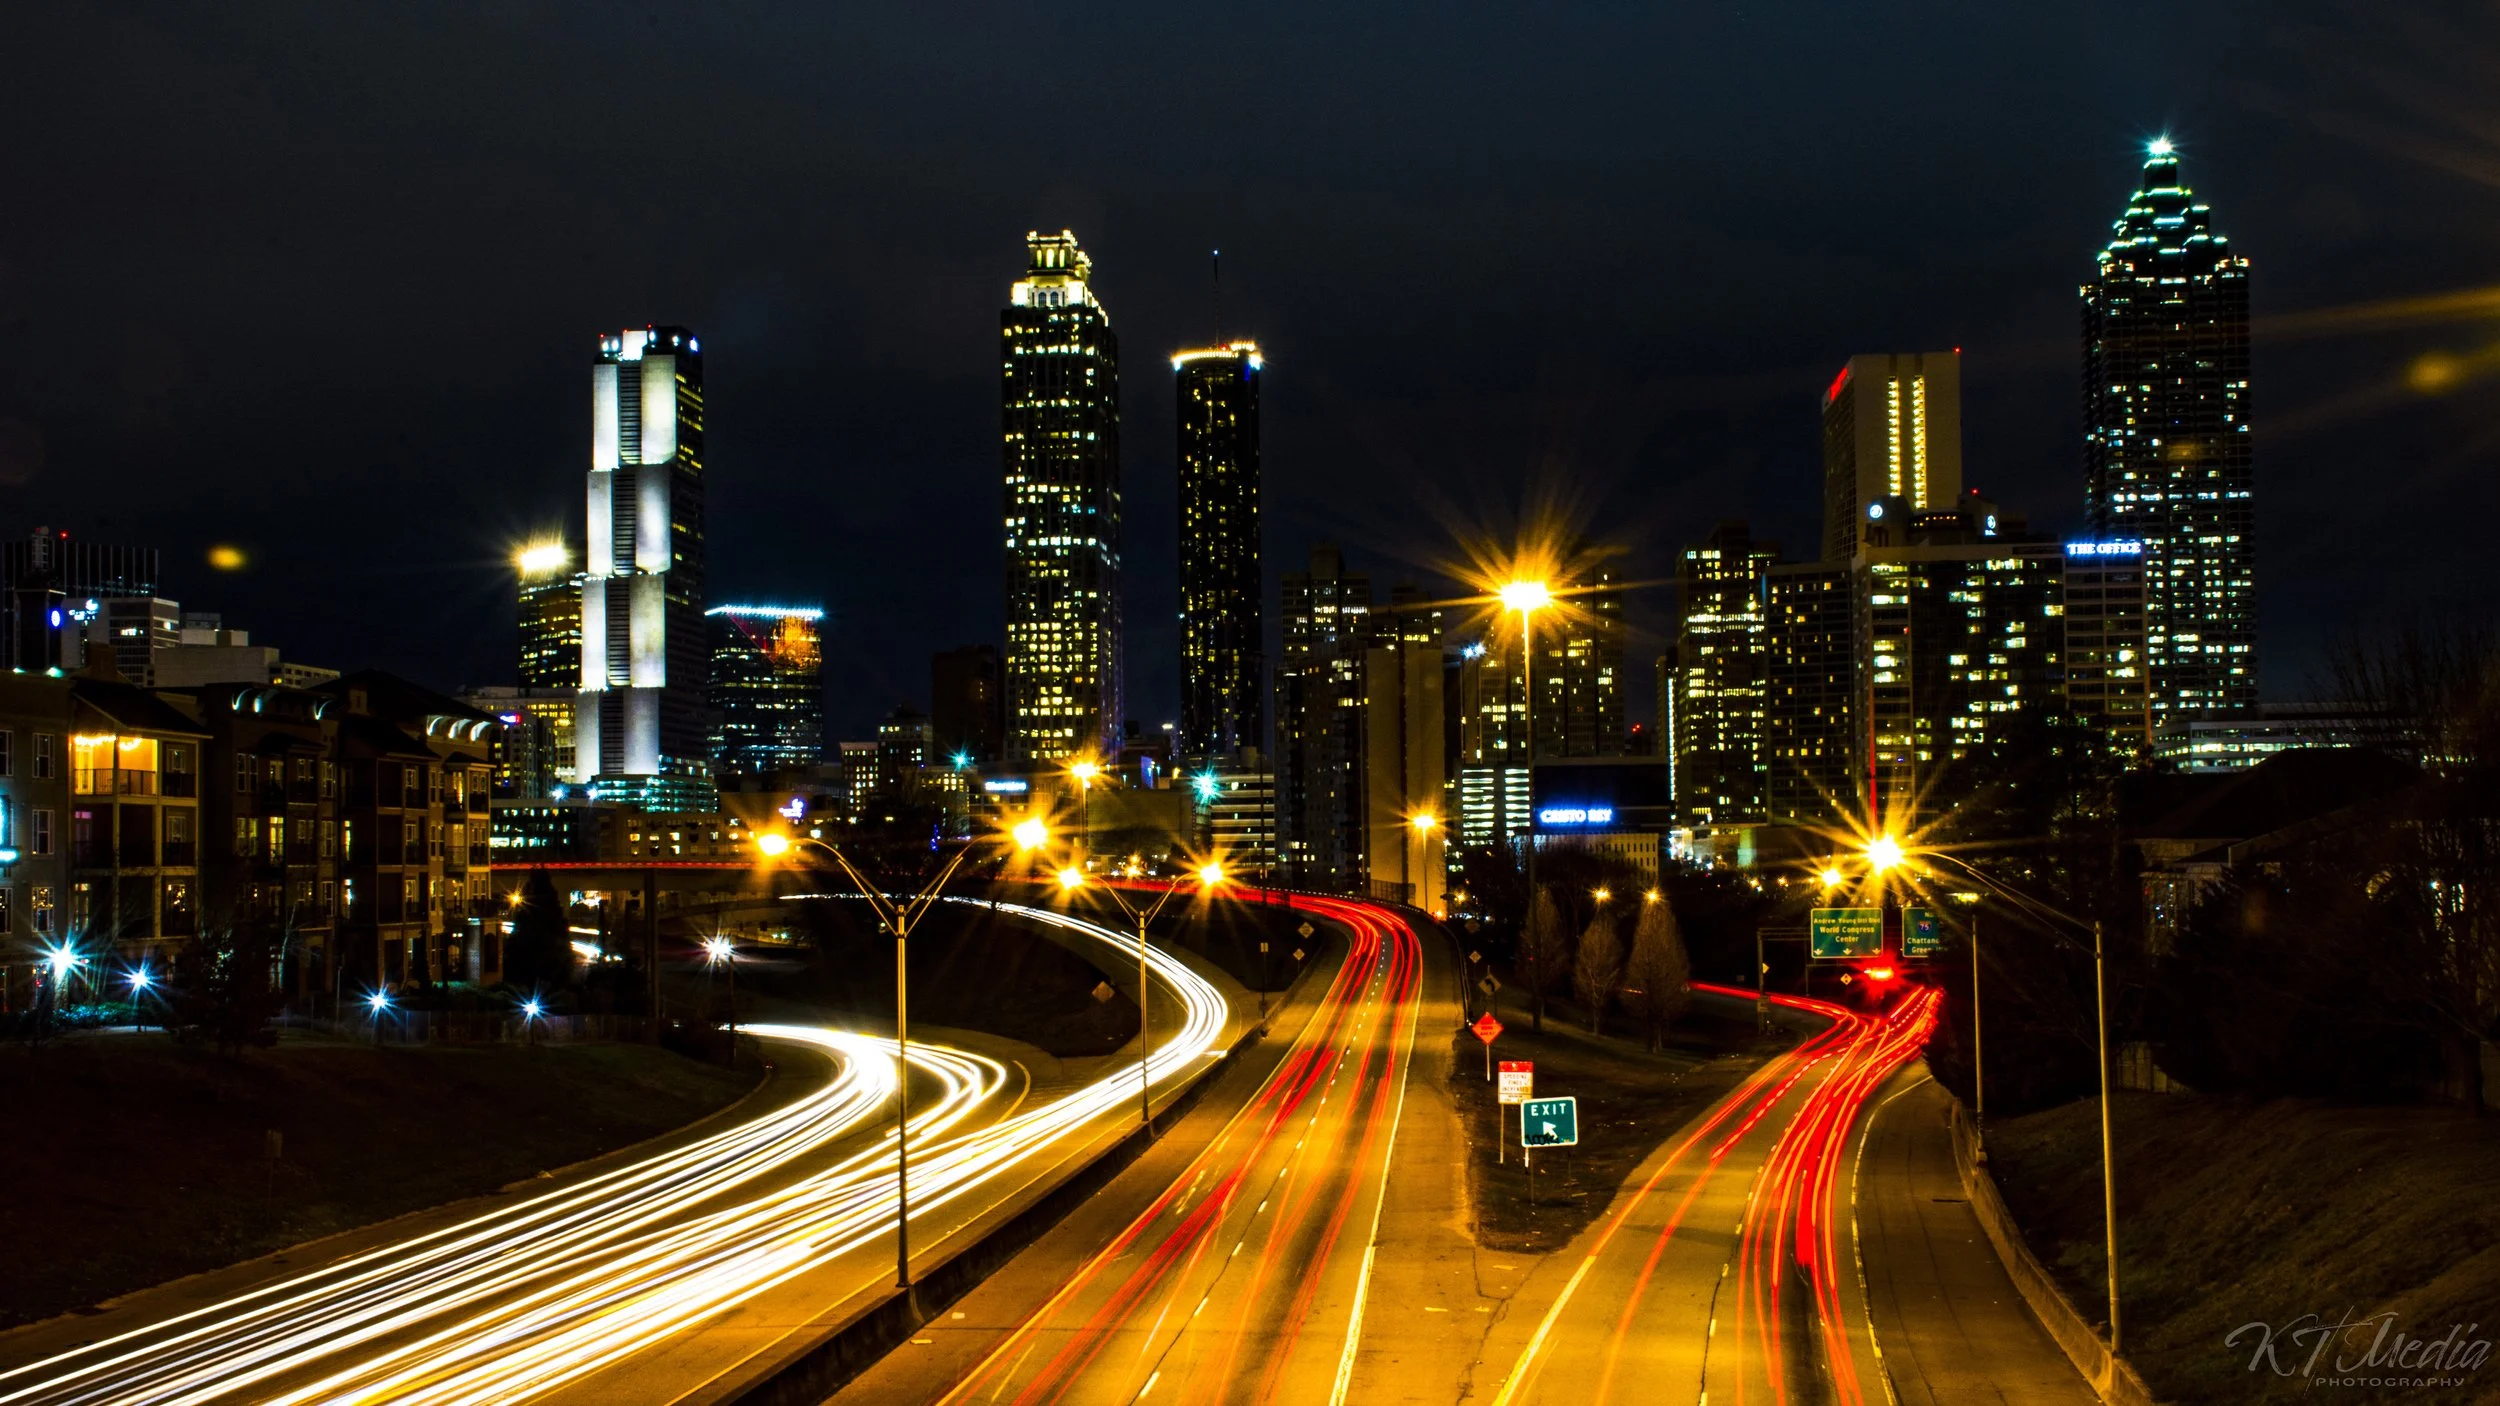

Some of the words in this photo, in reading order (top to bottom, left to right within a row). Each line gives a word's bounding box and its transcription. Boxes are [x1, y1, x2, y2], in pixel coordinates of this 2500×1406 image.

[2066, 543, 2096, 555] THE
[2096, 542, 2141, 554] OFFICE
[1838, 917, 1857, 925] Young
[1842, 926, 1875, 934] Congress
[1919, 923, 1930, 931] 75
[1835, 935, 1859, 943] Center
[1531, 1103, 1567, 1117] EXIT
